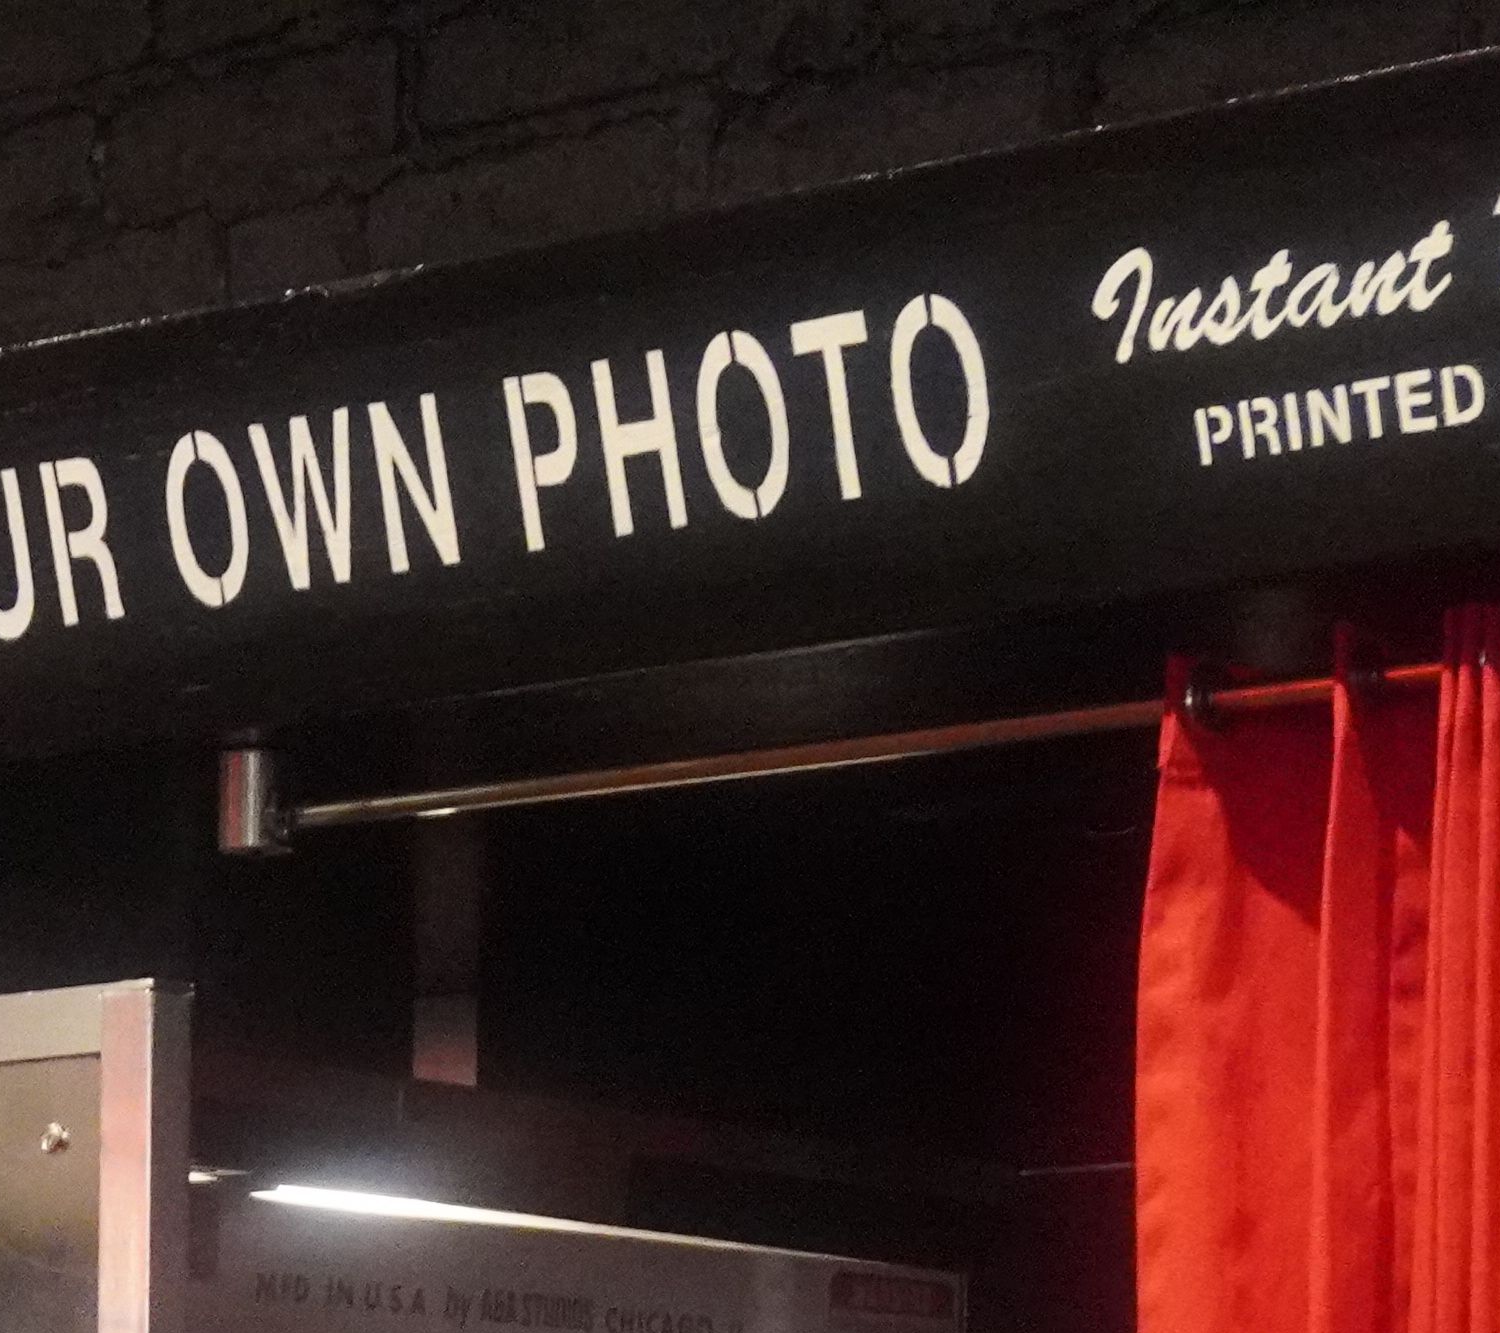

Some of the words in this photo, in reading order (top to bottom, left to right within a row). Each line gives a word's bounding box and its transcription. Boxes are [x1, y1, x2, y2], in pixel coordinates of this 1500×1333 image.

[1091, 219, 1454, 363] Instant
[164, 392, 462, 610] OWN
[503, 291, 990, 553] PHOTO
[1192, 363, 1485, 467] PRINTED
